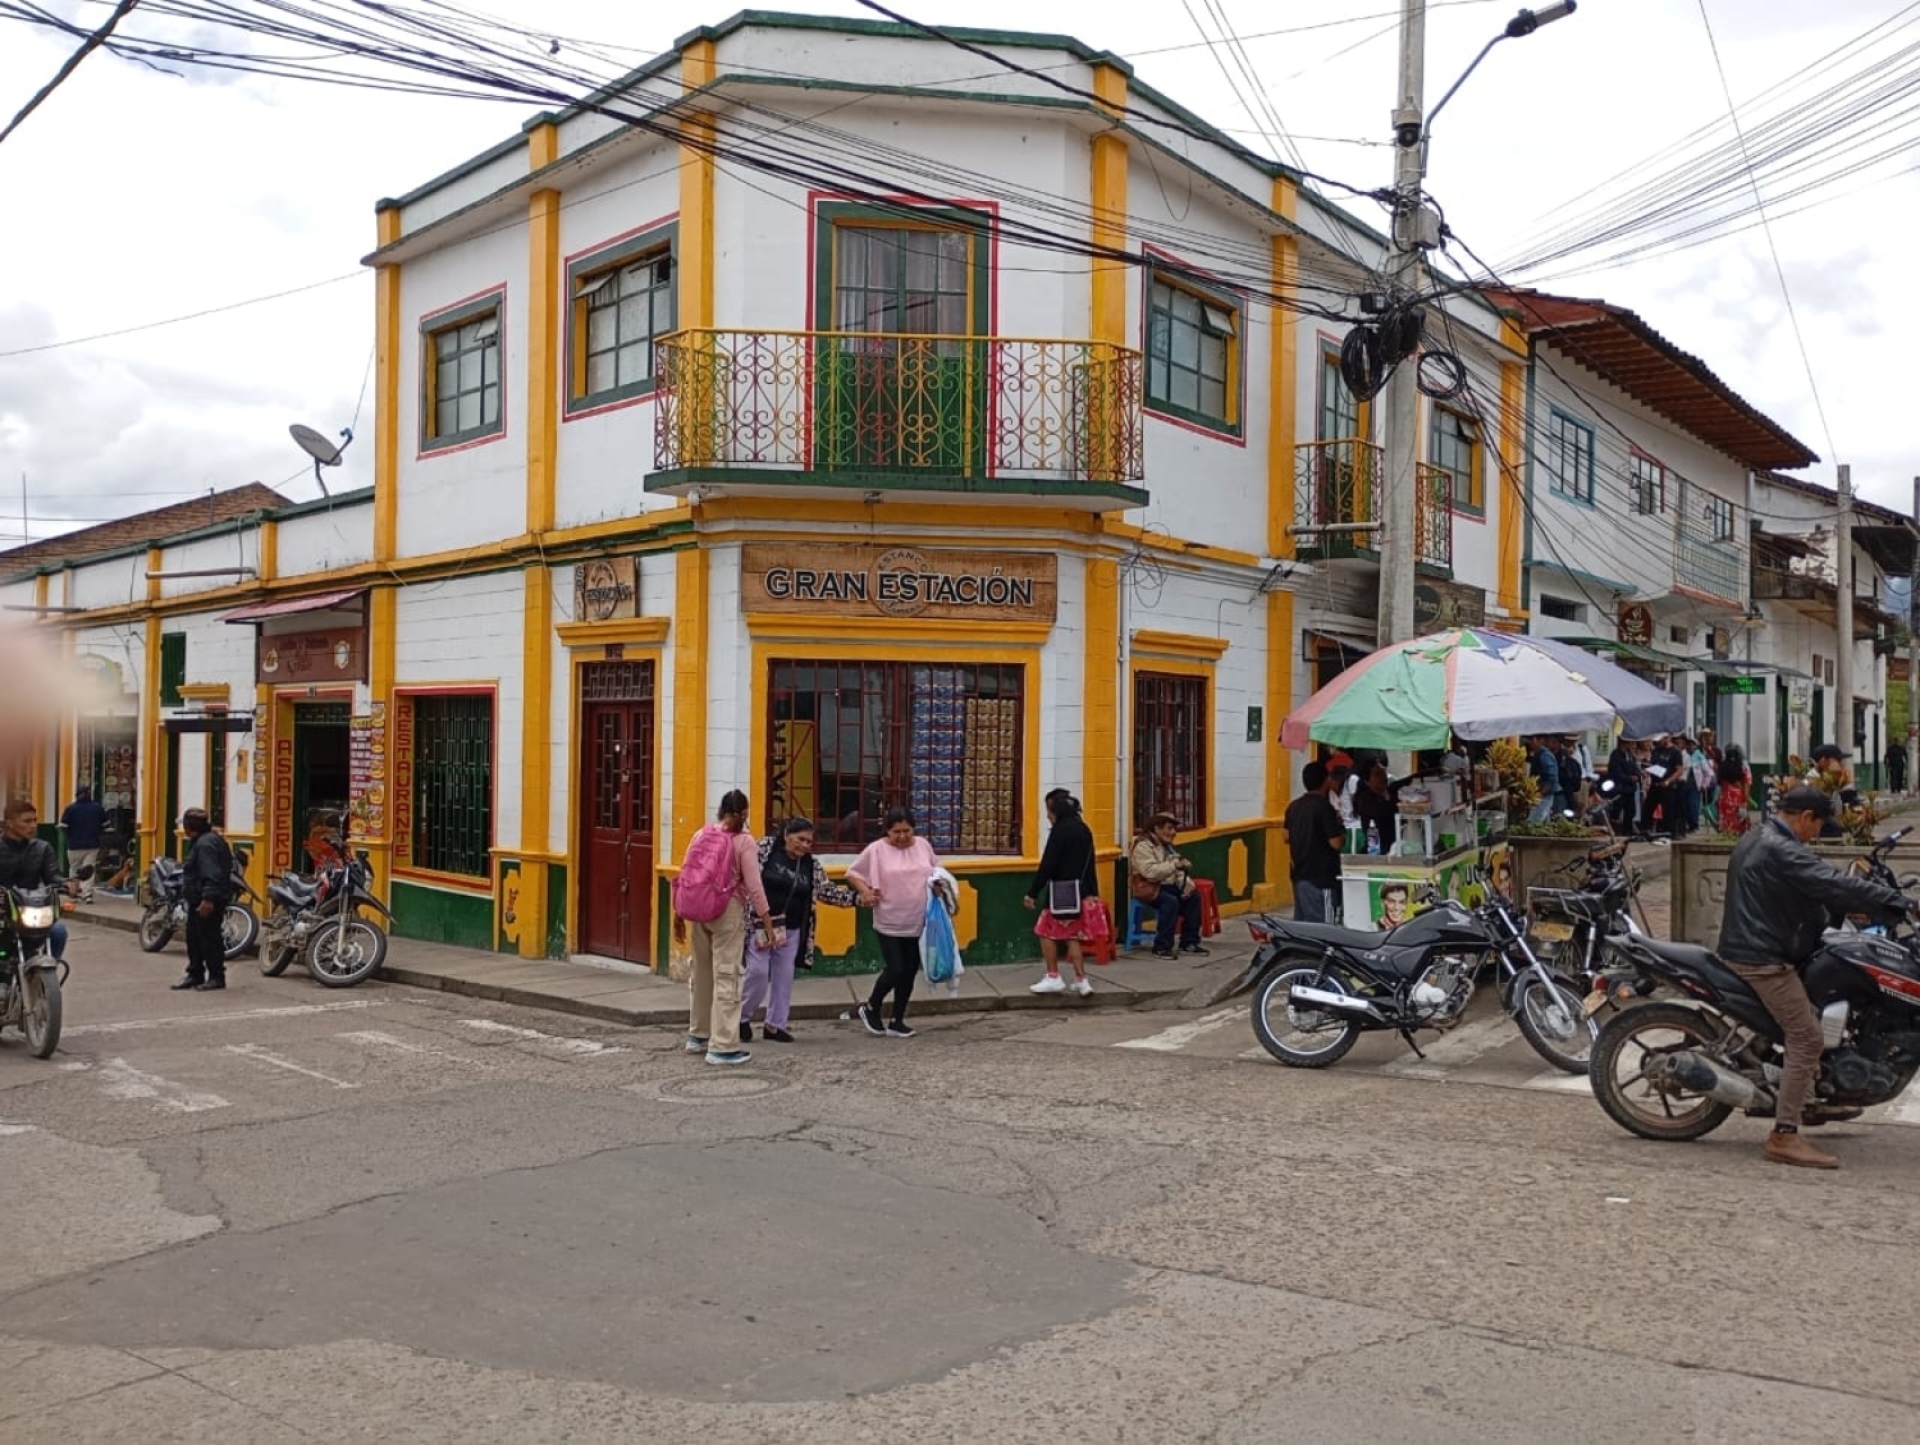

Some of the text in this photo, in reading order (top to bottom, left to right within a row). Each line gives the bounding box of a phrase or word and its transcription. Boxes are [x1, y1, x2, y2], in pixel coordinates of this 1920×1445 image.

[765, 566, 1033, 606] GRAN ESTACIÓN
[275, 739, 291, 867] ASADERO
[395, 704, 411, 858] RESTAURANTE
